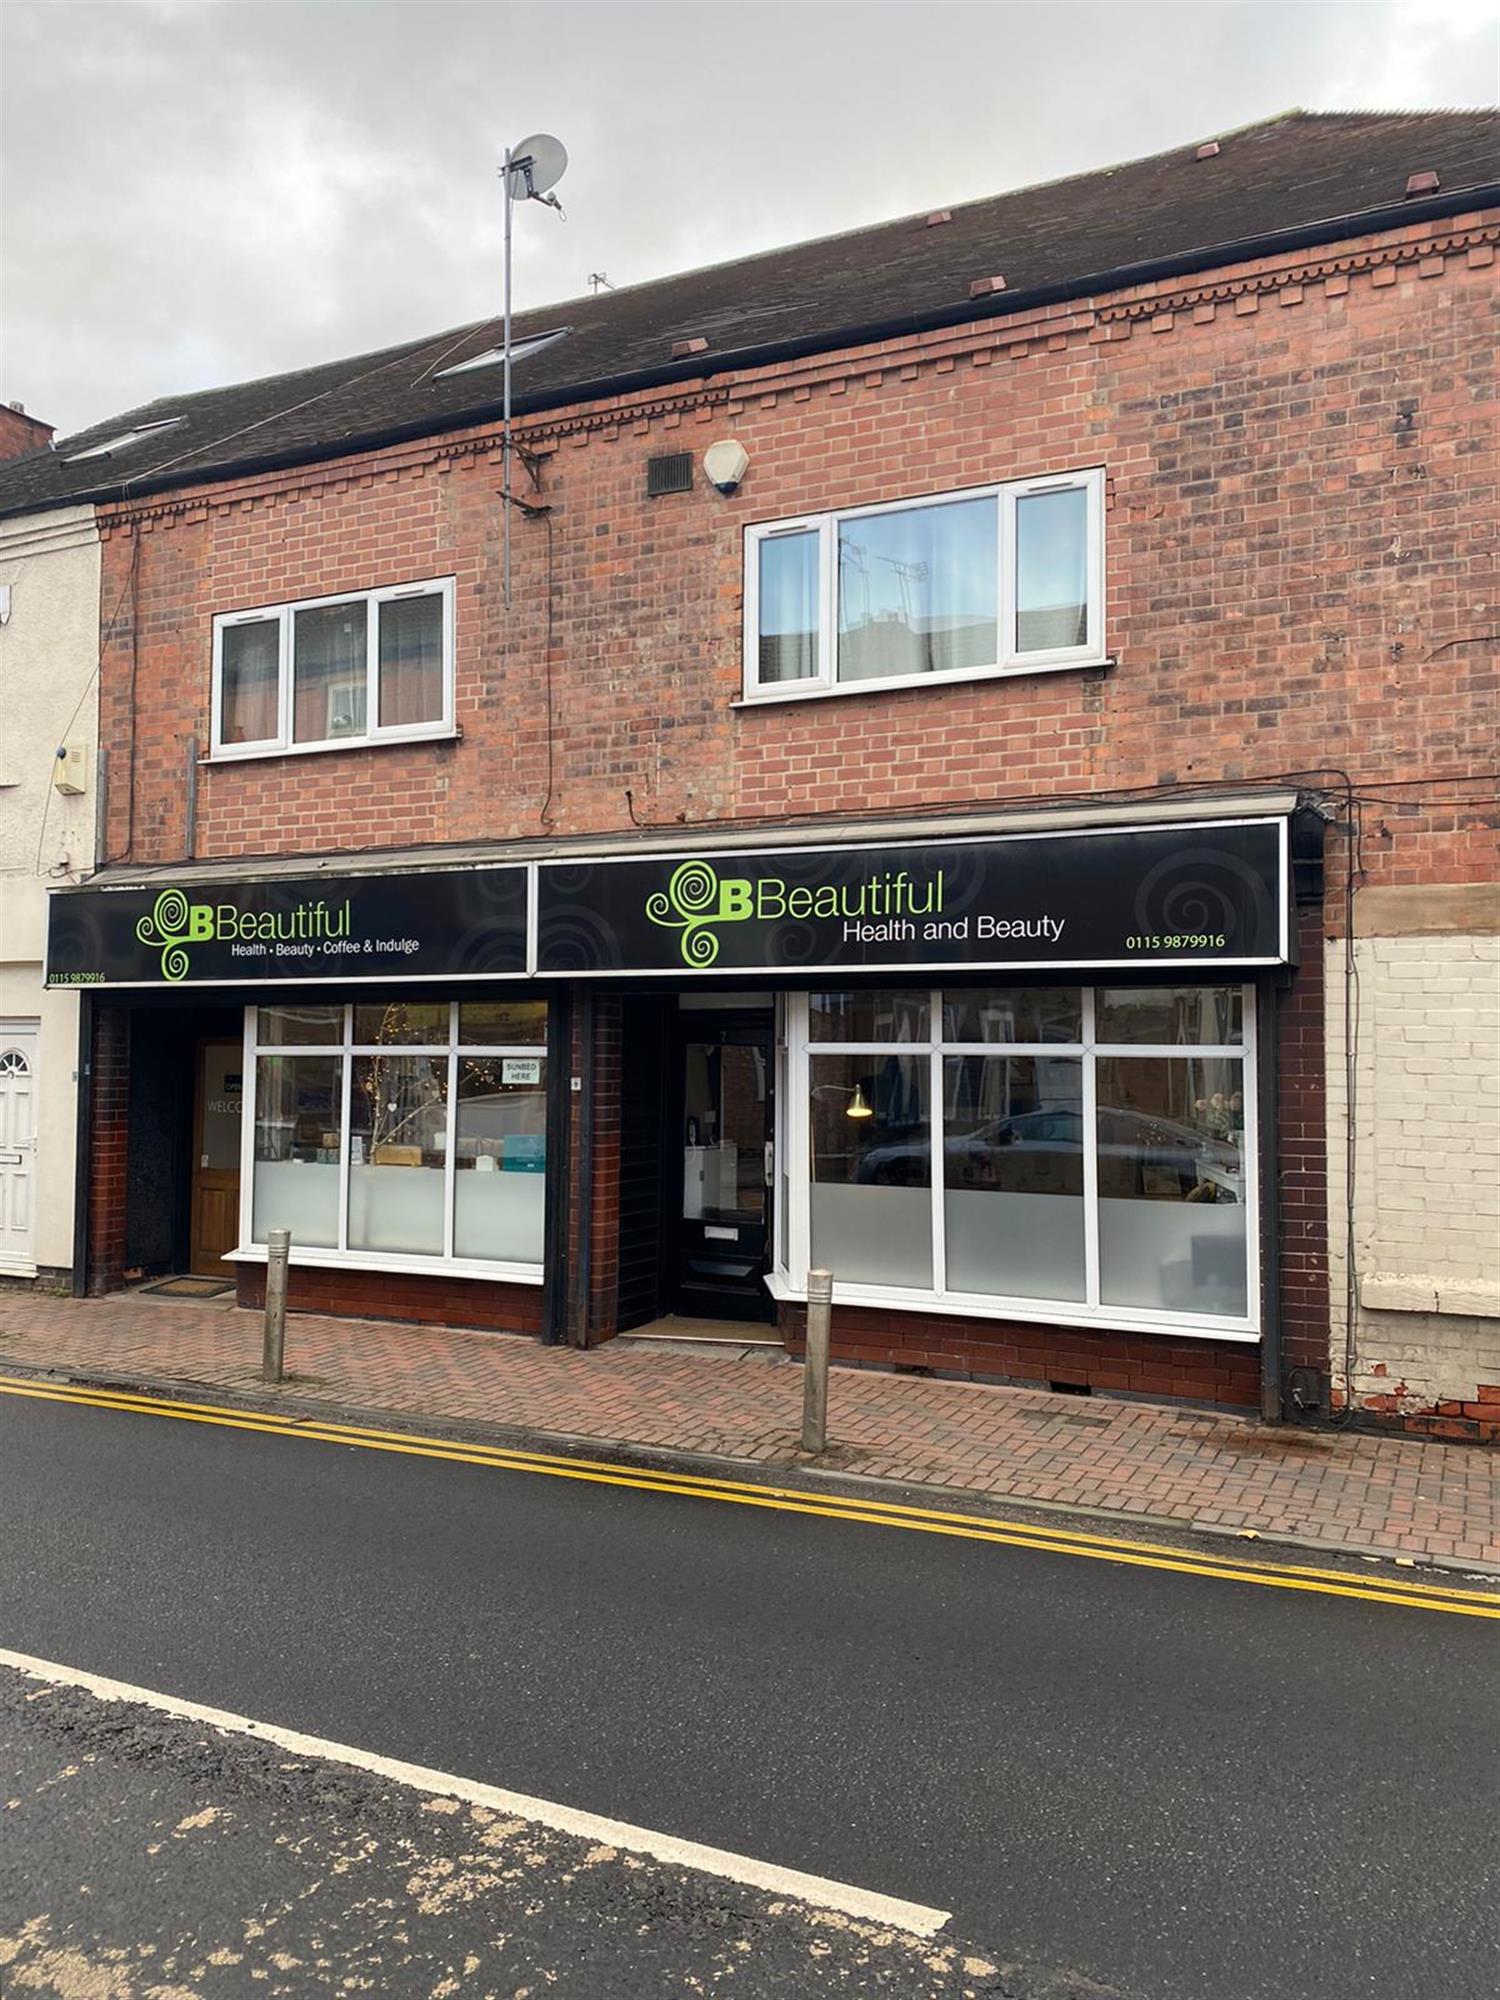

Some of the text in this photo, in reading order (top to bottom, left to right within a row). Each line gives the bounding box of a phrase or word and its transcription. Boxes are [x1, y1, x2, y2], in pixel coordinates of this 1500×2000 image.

[843, 914, 1065, 943] Health and Beauty
[231, 937, 420, 958] Health Beauty Coffee & Indulge
[1126, 934, 1226, 950] 0115 9879916
[49, 972, 105, 984] 0115 9879916
[506, 1062, 537, 1071] SUNBED
[511, 1072, 531, 1080] HERE
[208, 1100, 243, 1113] WELCO
